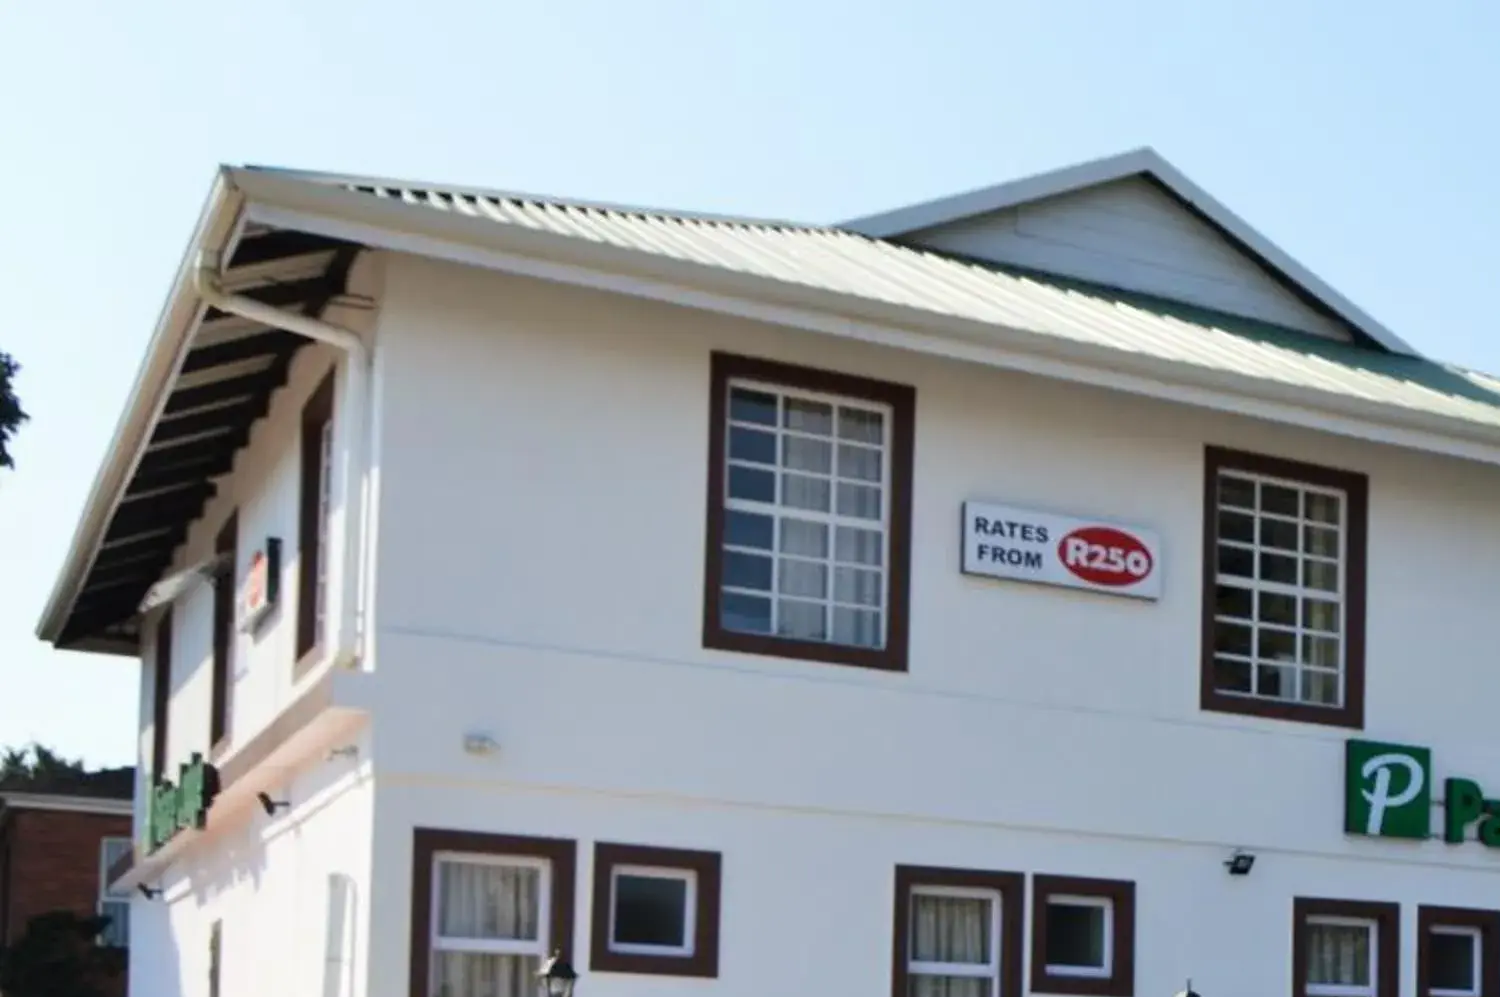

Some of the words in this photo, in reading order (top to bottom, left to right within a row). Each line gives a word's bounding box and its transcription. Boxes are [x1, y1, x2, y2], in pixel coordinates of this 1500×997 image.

[975, 516, 1049, 543] RATES
[977, 544, 1043, 569] FROM
[1066, 537, 1149, 576] R250
[1361, 753, 1424, 835] P
